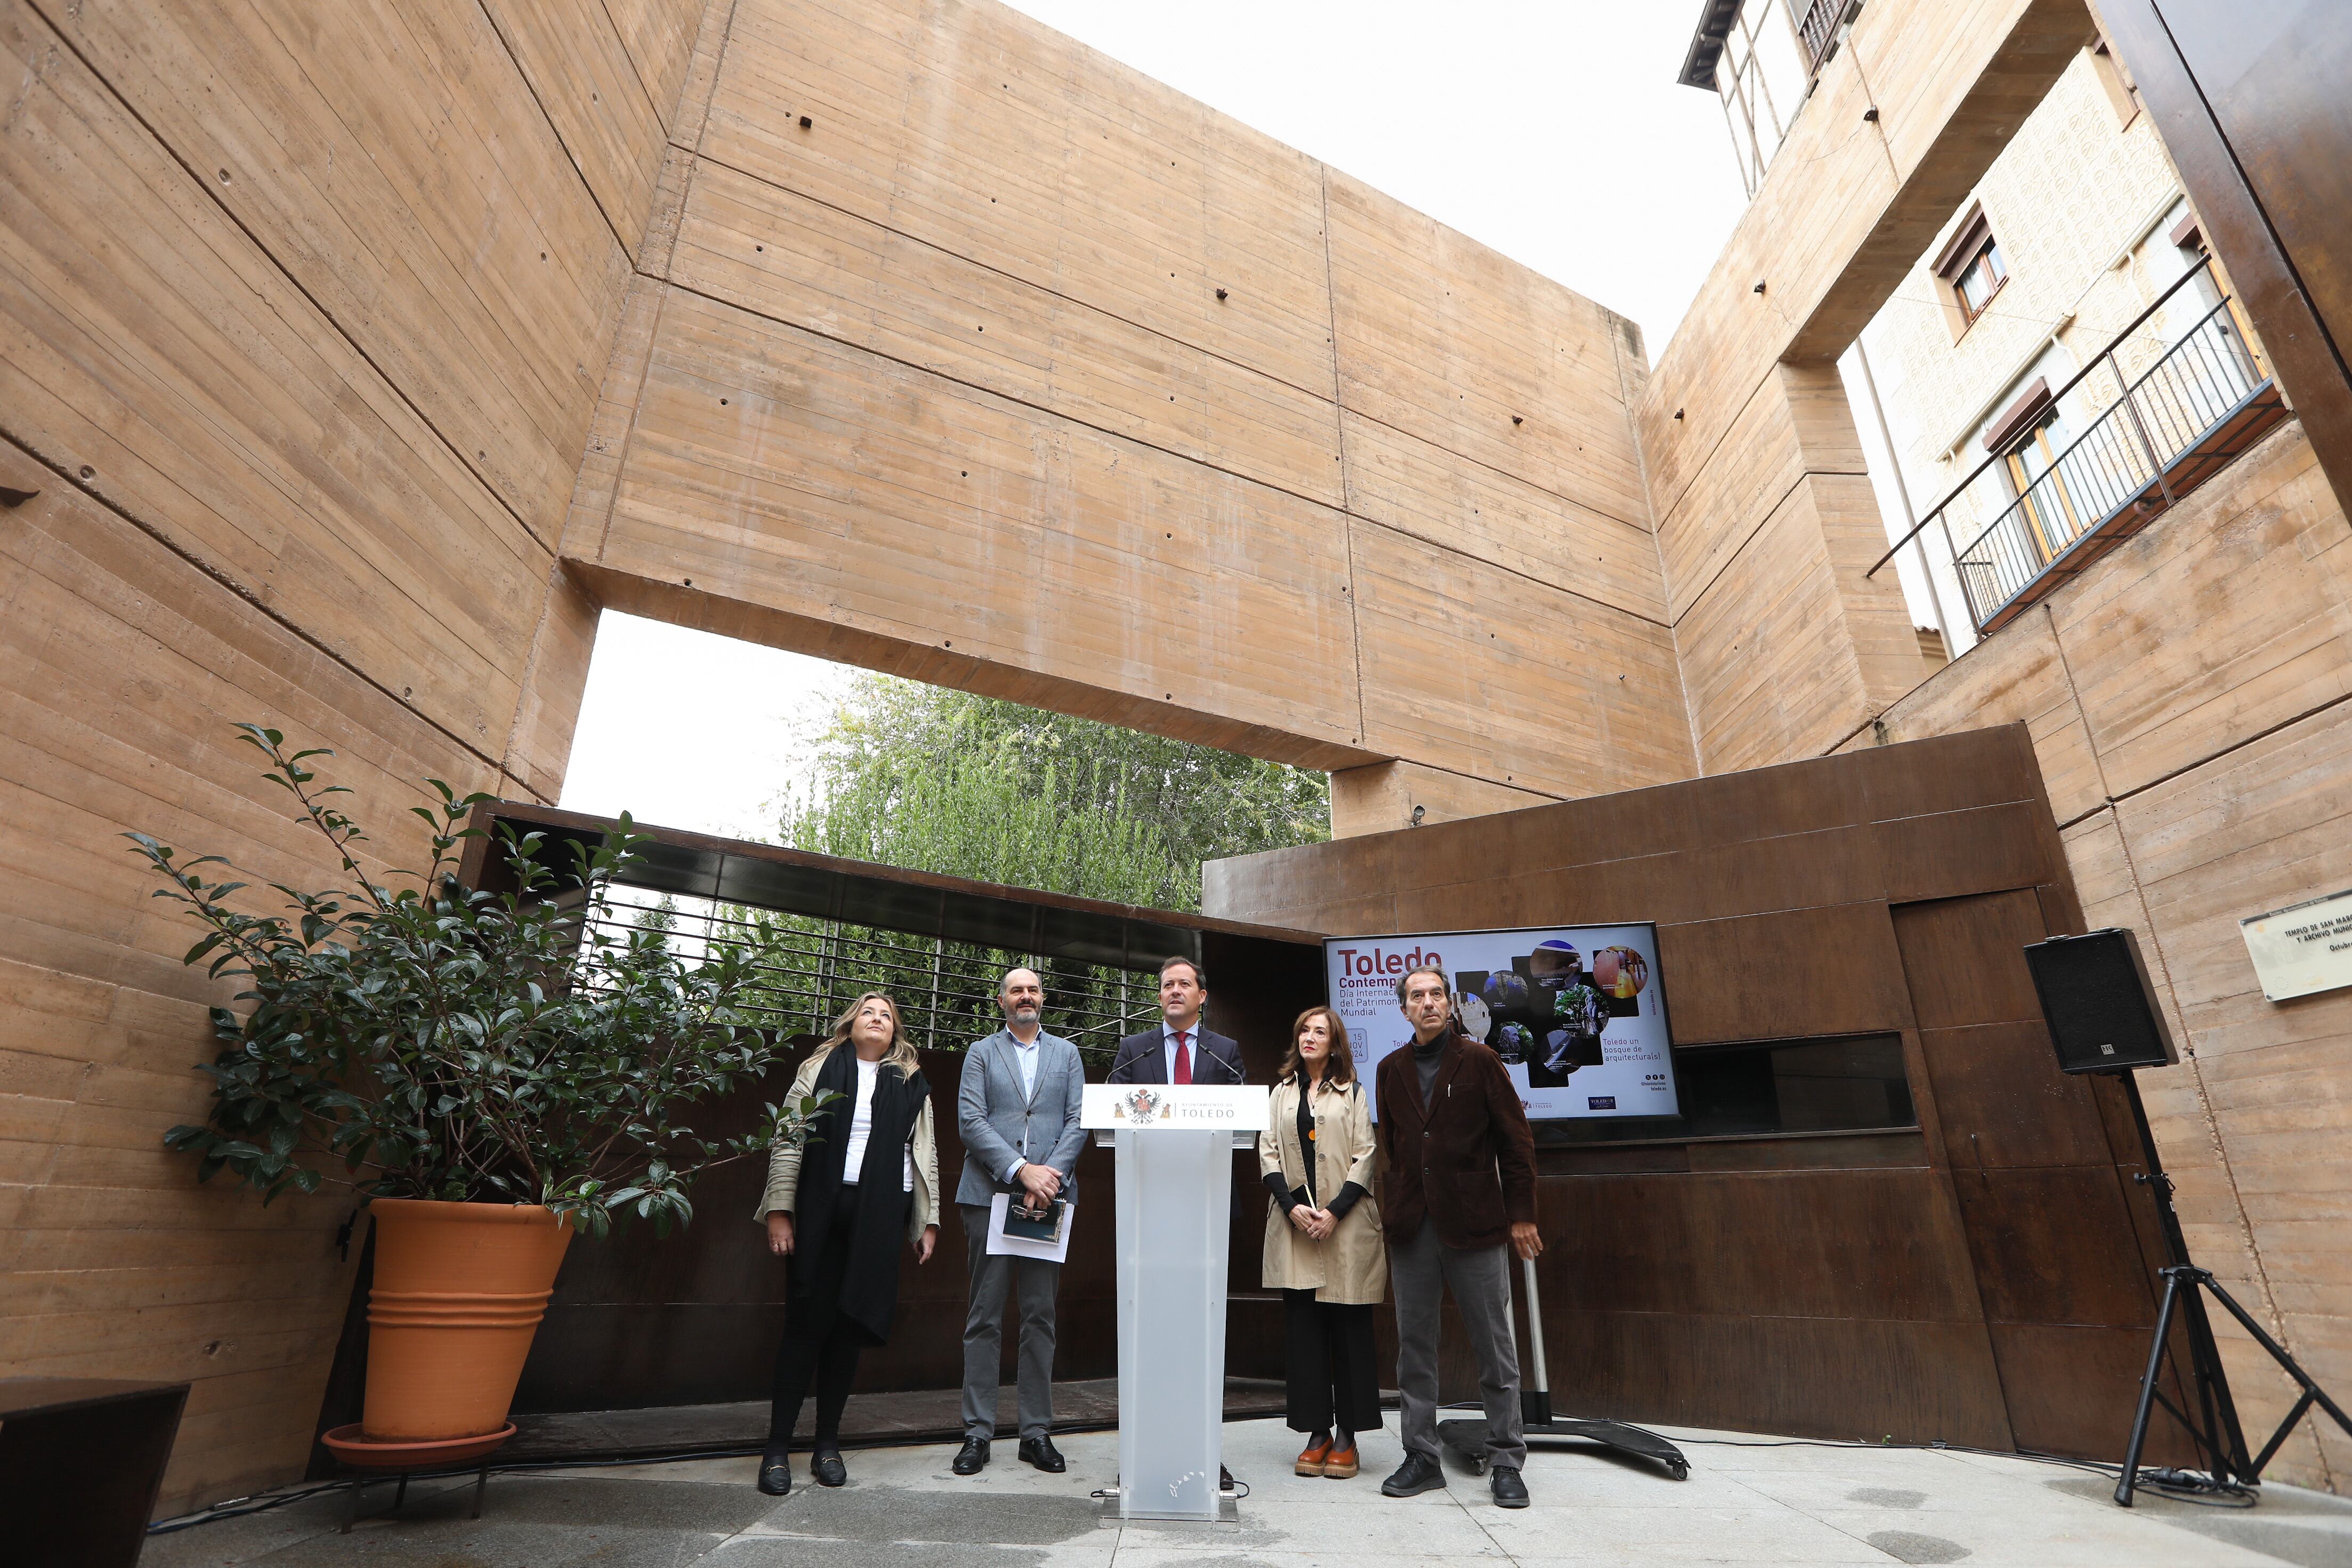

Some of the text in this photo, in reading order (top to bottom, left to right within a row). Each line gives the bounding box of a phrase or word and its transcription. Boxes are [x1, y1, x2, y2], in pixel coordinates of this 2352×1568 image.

[2285, 926, 2308, 937] TEMPLO
[2303, 930, 2330, 942] ARCHIVO
[2330, 941, 2352, 951] Octubr
[1338, 946, 1442, 976] Toledo
[1339, 977, 1396, 989] Contemp
[1340, 988, 1396, 998] Día Internaci
[1357, 998, 1400, 1007] Patrimoni
[1341, 1008, 1376, 1016] Mundial
[1605, 1053, 1661, 1062] arquitectura(s)
[1181, 1109, 1234, 1118] TOLEDO
